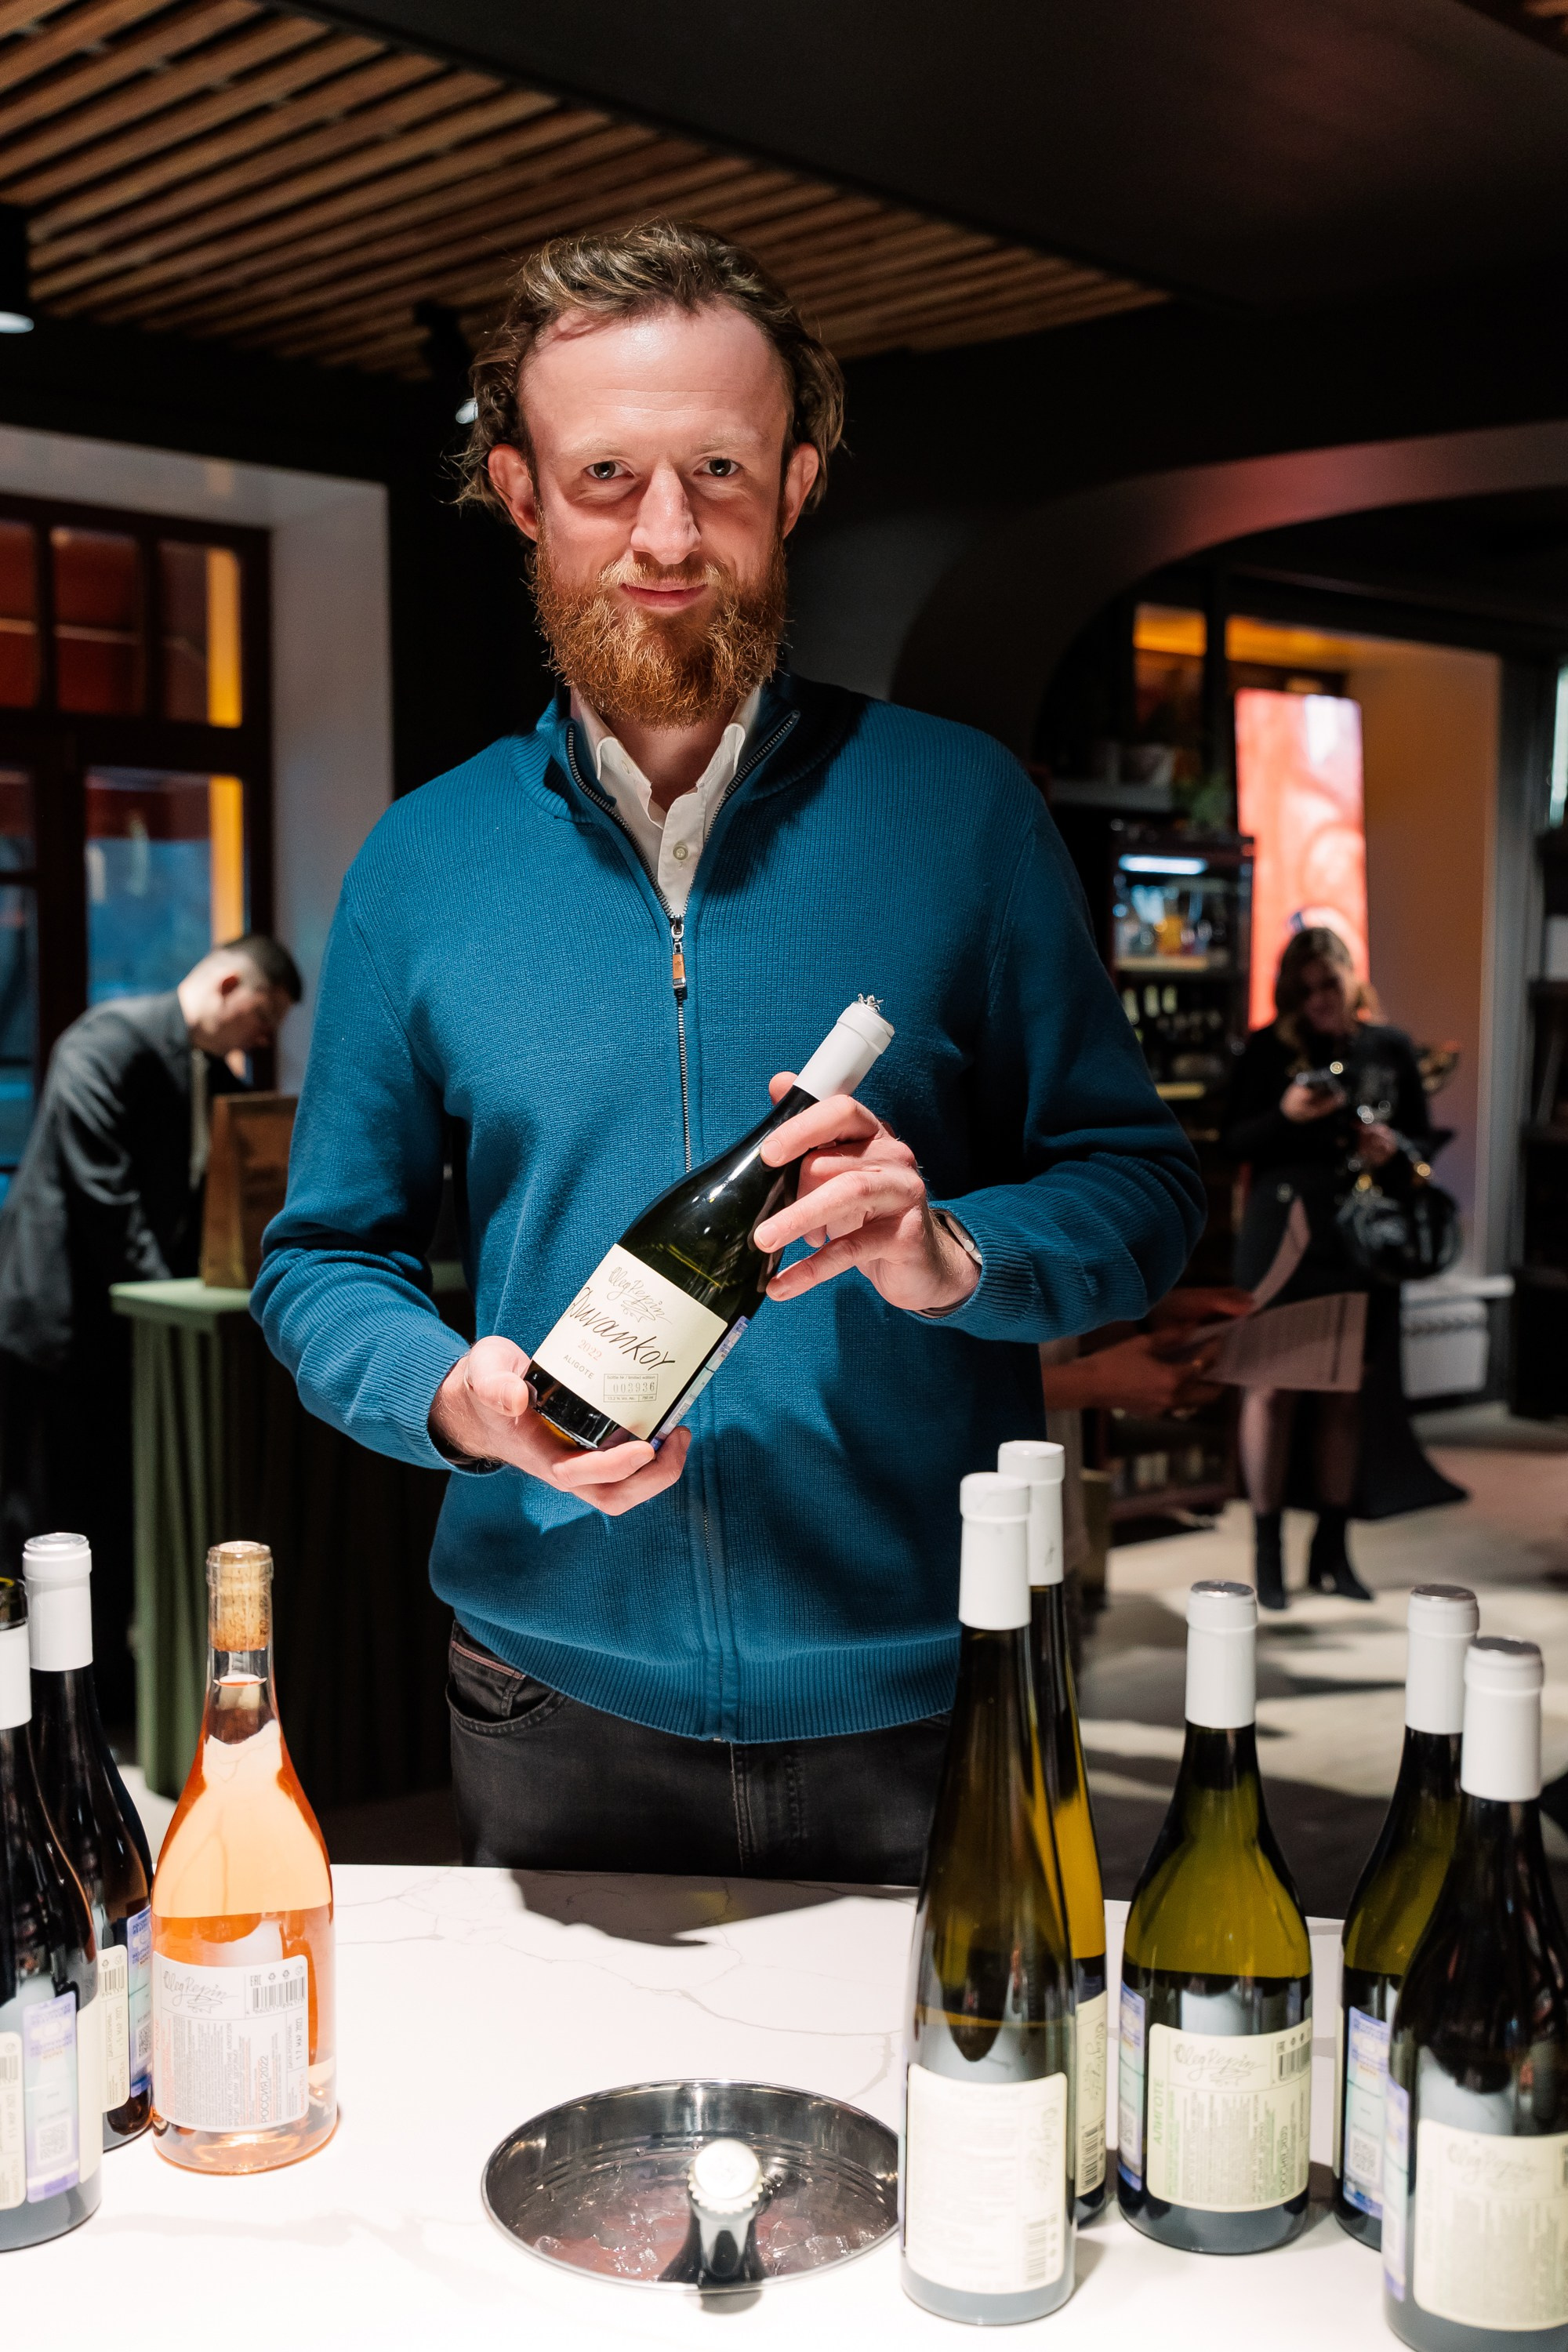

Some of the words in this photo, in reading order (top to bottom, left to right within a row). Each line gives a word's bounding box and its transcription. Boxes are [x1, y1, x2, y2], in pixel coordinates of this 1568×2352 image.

[578, 1338, 603, 1362] 2022
[563, 1354, 594, 1380] ALIGOTE
[613, 1381, 655, 1394] 003936
[1152, 2078, 1165, 2146] АЛИГОТЕ
